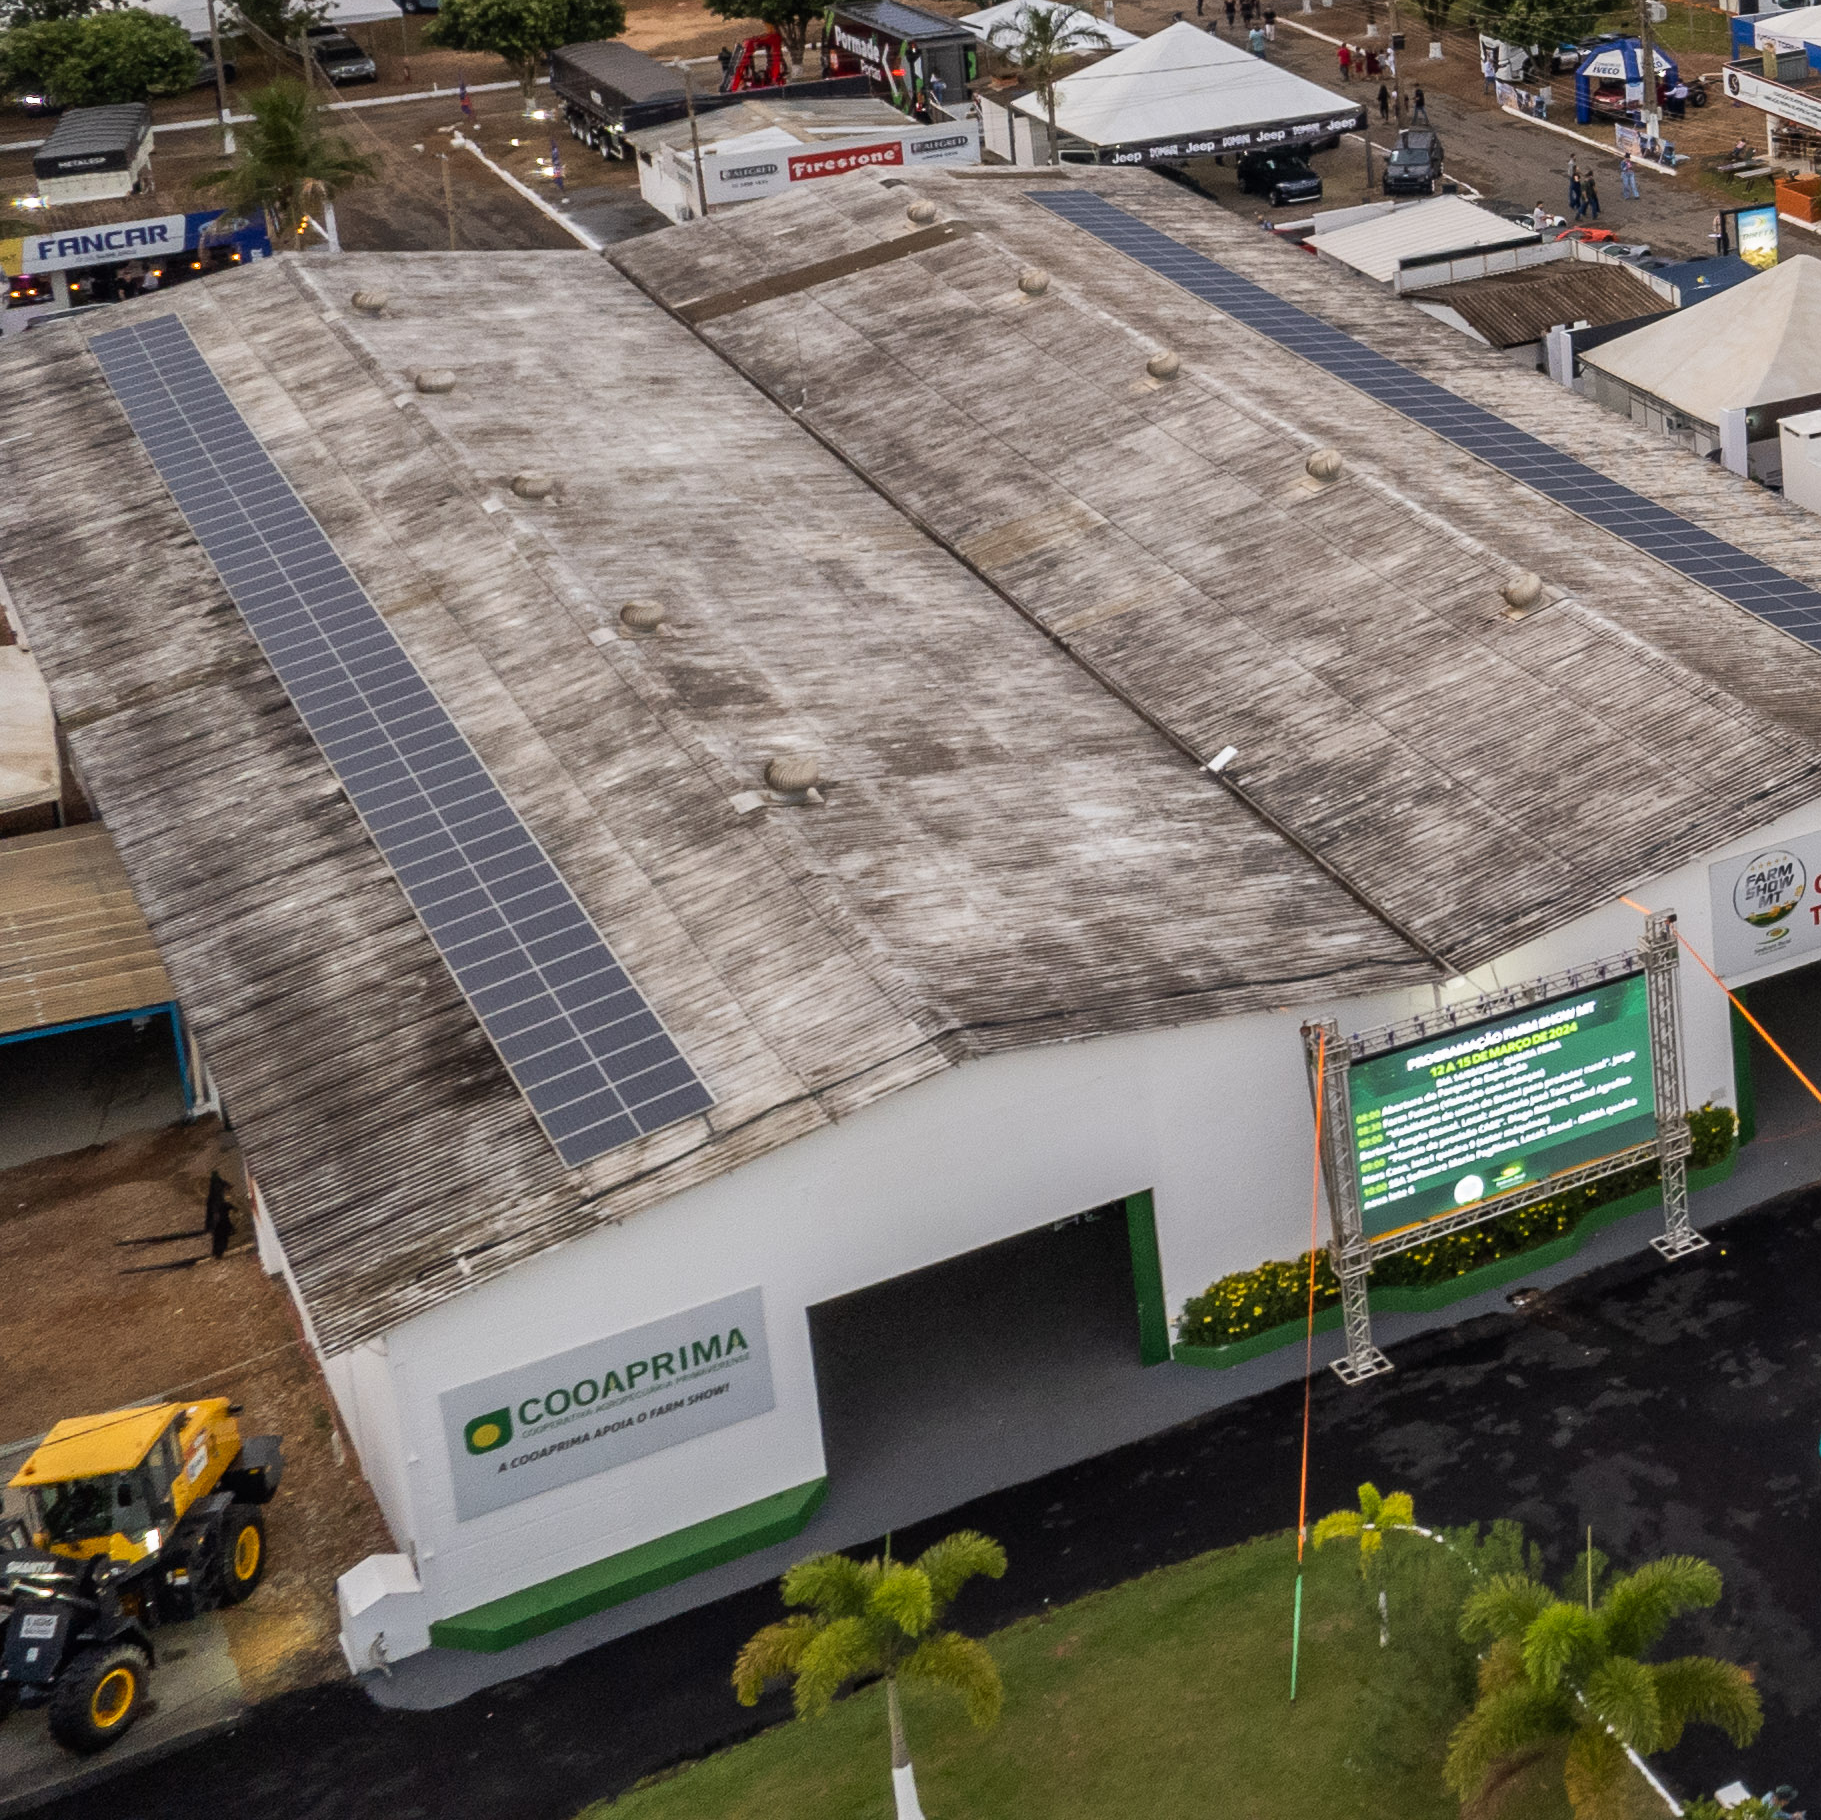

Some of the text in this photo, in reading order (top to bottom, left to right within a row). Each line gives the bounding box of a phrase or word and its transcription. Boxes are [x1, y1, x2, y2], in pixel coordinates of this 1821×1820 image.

[1592, 66, 1620, 75] IVECO
[1112, 117, 1357, 164] Jeep Jeep Jeep Jeep
[792, 150, 895, 178] Firestone
[38, 224, 169, 260] FANCAR
[1745, 874, 1794, 901] SHOW
[1746, 862, 1793, 888] FARM
[1758, 890, 1783, 909] MT
[1406, 1000, 1596, 1072] PROGRAMAÇÃO FARM SHOW MT
[1430, 1022, 1577, 1078] 12 A 15 DE MARÇO DE 2024
[518, 1326, 748, 1426] COOAPRIMA
[498, 1381, 731, 1473] A COOAPRIMA APOIA O FARM SHOW!
